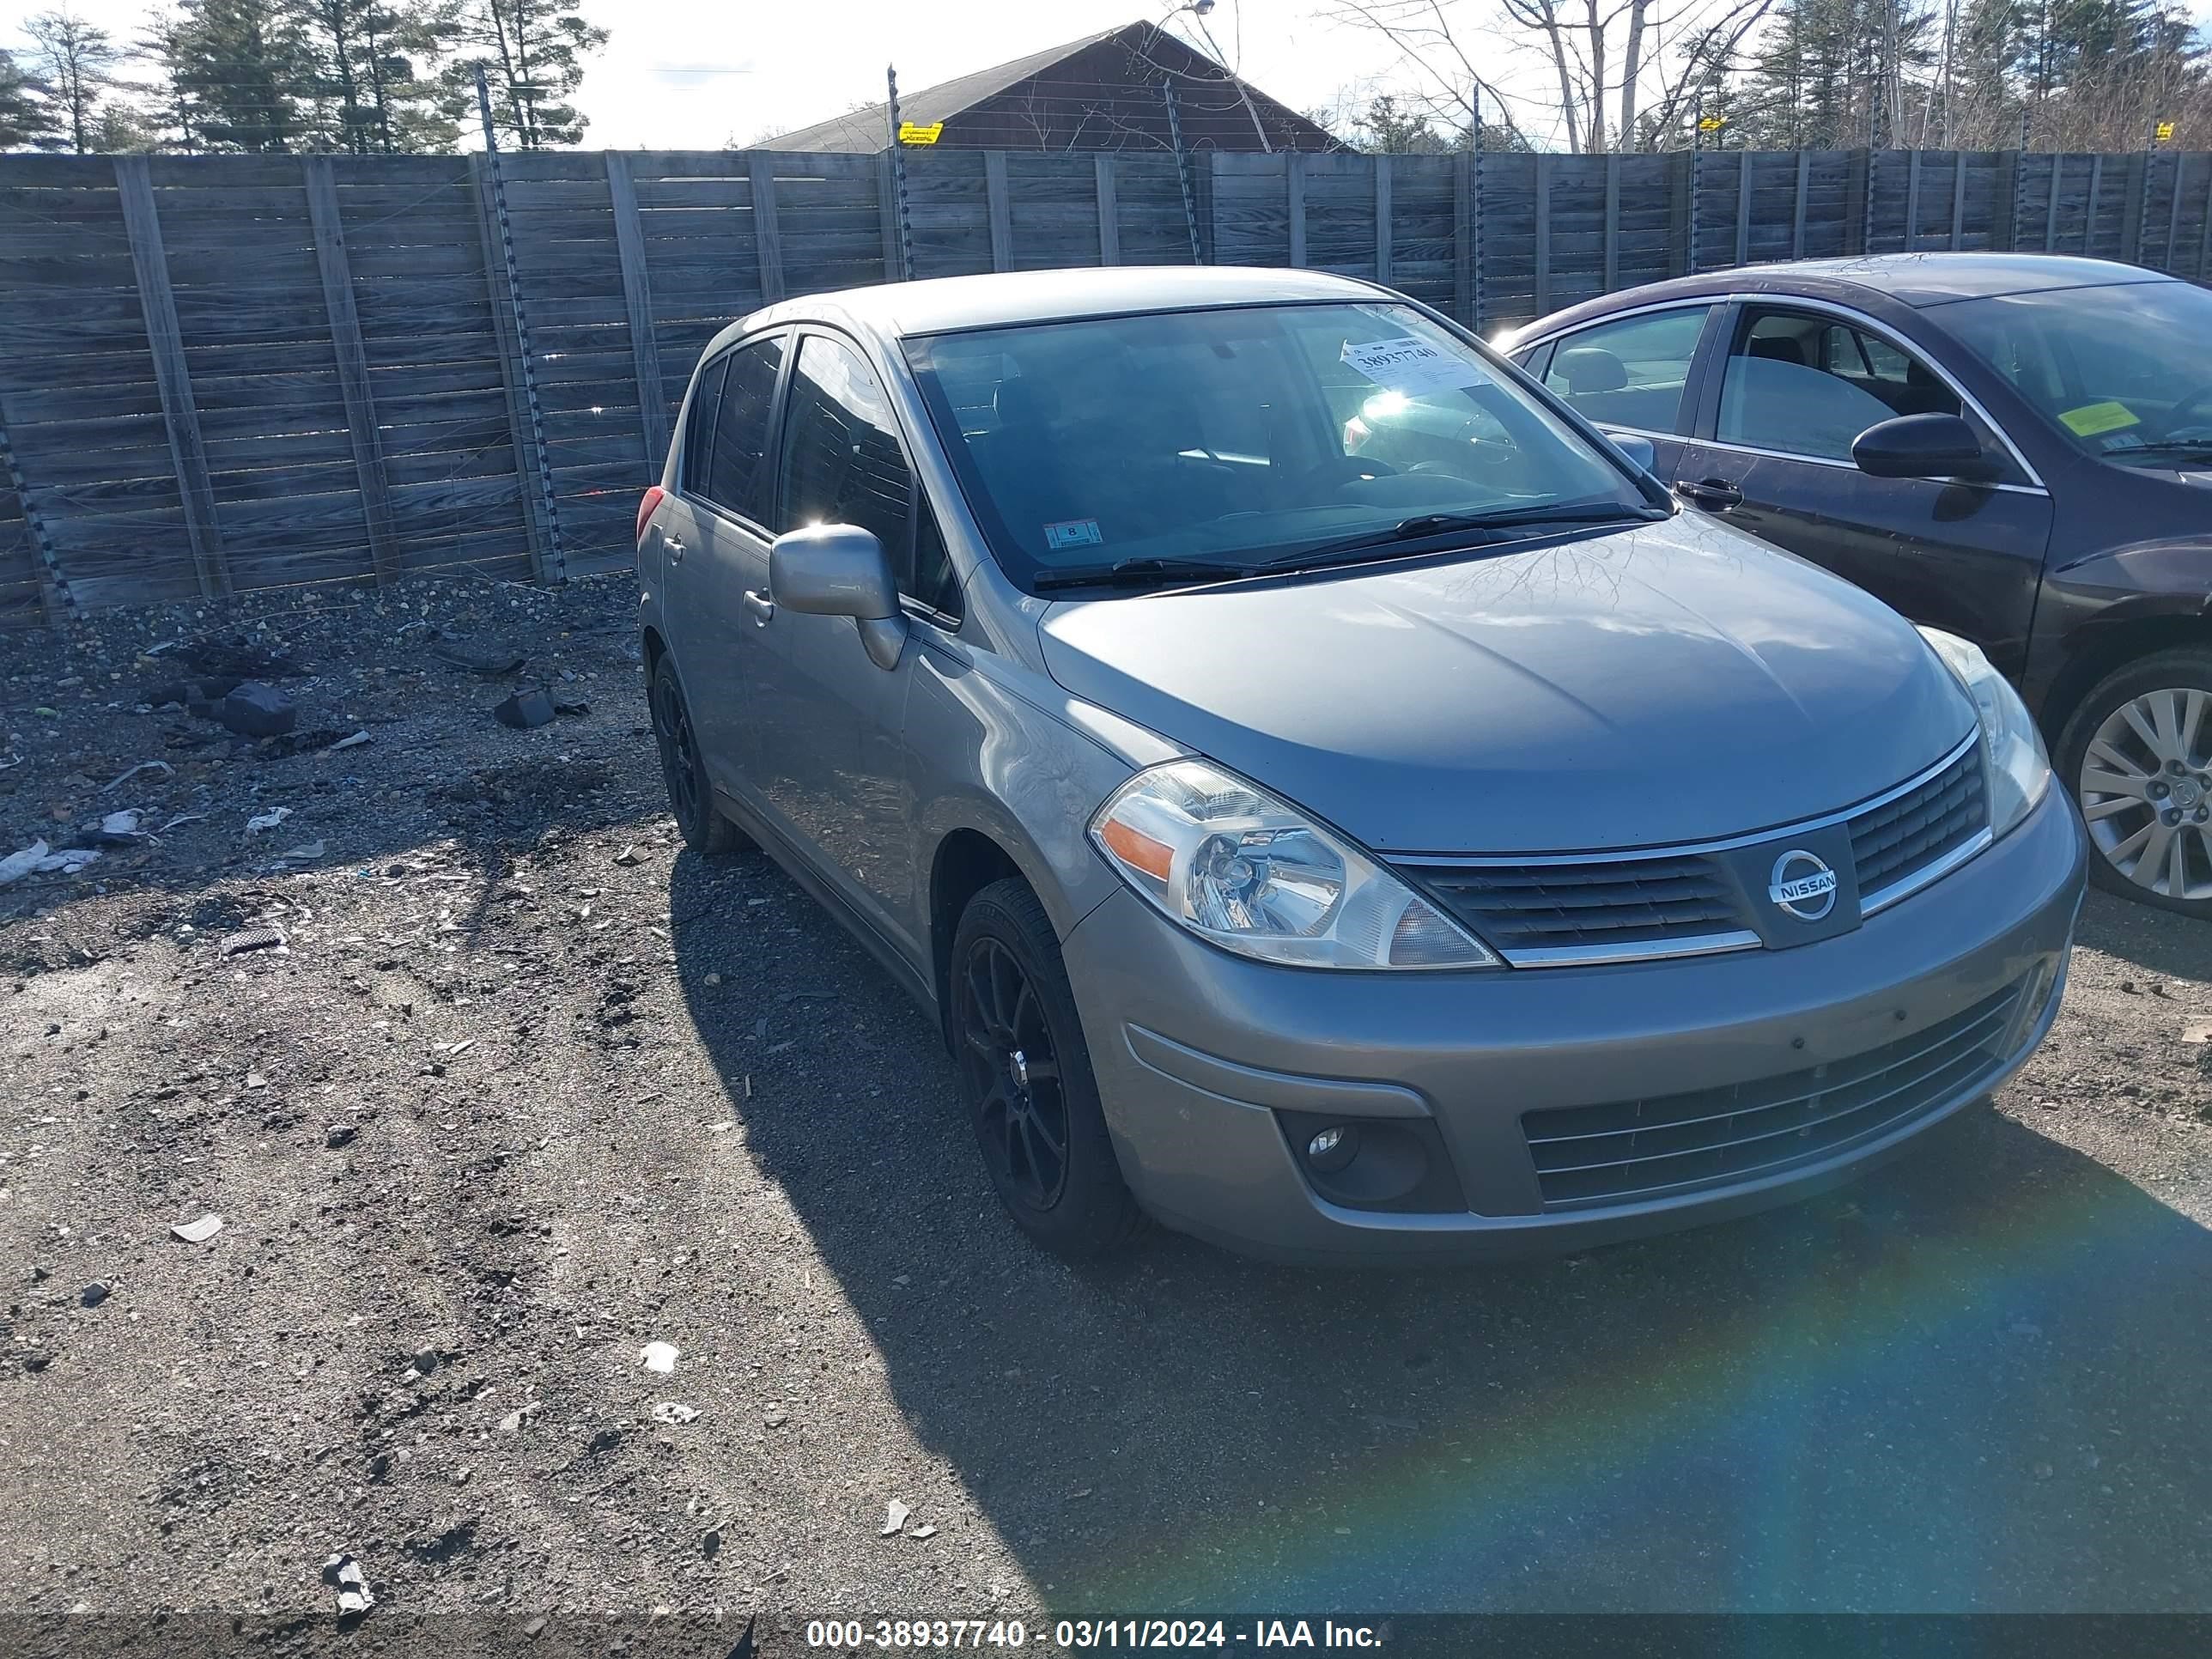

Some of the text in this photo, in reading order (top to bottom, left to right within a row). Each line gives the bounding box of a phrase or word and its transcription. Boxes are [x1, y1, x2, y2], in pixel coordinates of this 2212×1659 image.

[1358, 348, 1438, 368] 38937740
[1067, 527, 1078, 537] 8
[1781, 874, 1836, 899] NISSAN
